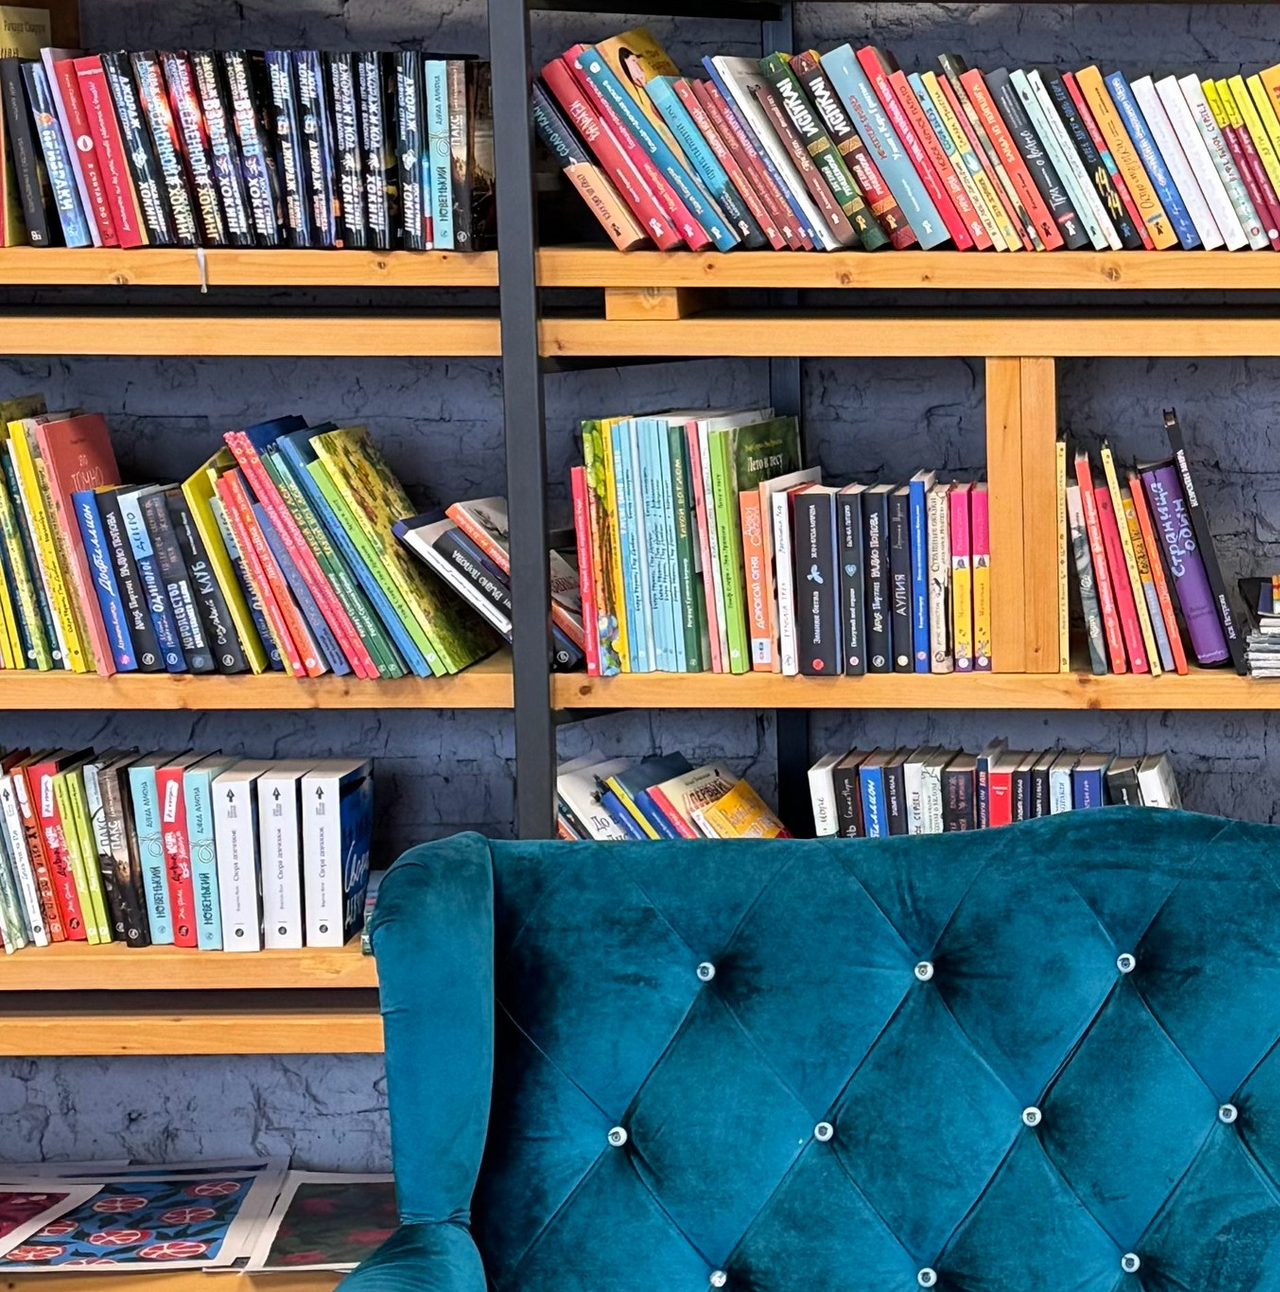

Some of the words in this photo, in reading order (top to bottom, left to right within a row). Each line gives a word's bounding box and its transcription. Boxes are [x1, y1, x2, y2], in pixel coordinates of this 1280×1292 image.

[270, 63, 284, 109] ХОКИНГ
[298, 62, 310, 107] ХОКИНГ
[403, 76, 417, 132] ДЖОРДЖ
[776, 77, 820, 138] ИСТУКАН
[808, 75, 852, 137] ИСТУКАН
[450, 114, 462, 147] ПАКС
[281, 140, 297, 193] ДЖОРДЖ
[308, 139, 324, 192] ДЖОРДЖ
[138, 181, 160, 234] ХОКИНГ
[169, 186, 191, 240] ХОКИНГ
[197, 187, 220, 241] ХОКИНГ
[220, 177, 241, 235] ХОКИНГ
[249, 177, 268, 235] ХОКИНГ
[341, 173, 355, 232] ХОКИНГ
[366, 173, 379, 232] ХОКИНГ
[403, 182, 415, 236] ХОКИНГ
[106, 511, 125, 547] ПОПОВА
[114, 547, 131, 577] РАДИО
[191, 561, 214, 596] КЛУБ
[870, 548, 880, 578] РАДИО
[166, 583, 195, 650] КОРОЛЕВСТВО
[895, 573, 907, 616] АУЛИЯ
[111, 820, 124, 851] ПАКС
[156, 866, 167, 919] НОВЕНЬКИЙ
[202, 872, 212, 926] НОВЕНЬКИЙ
